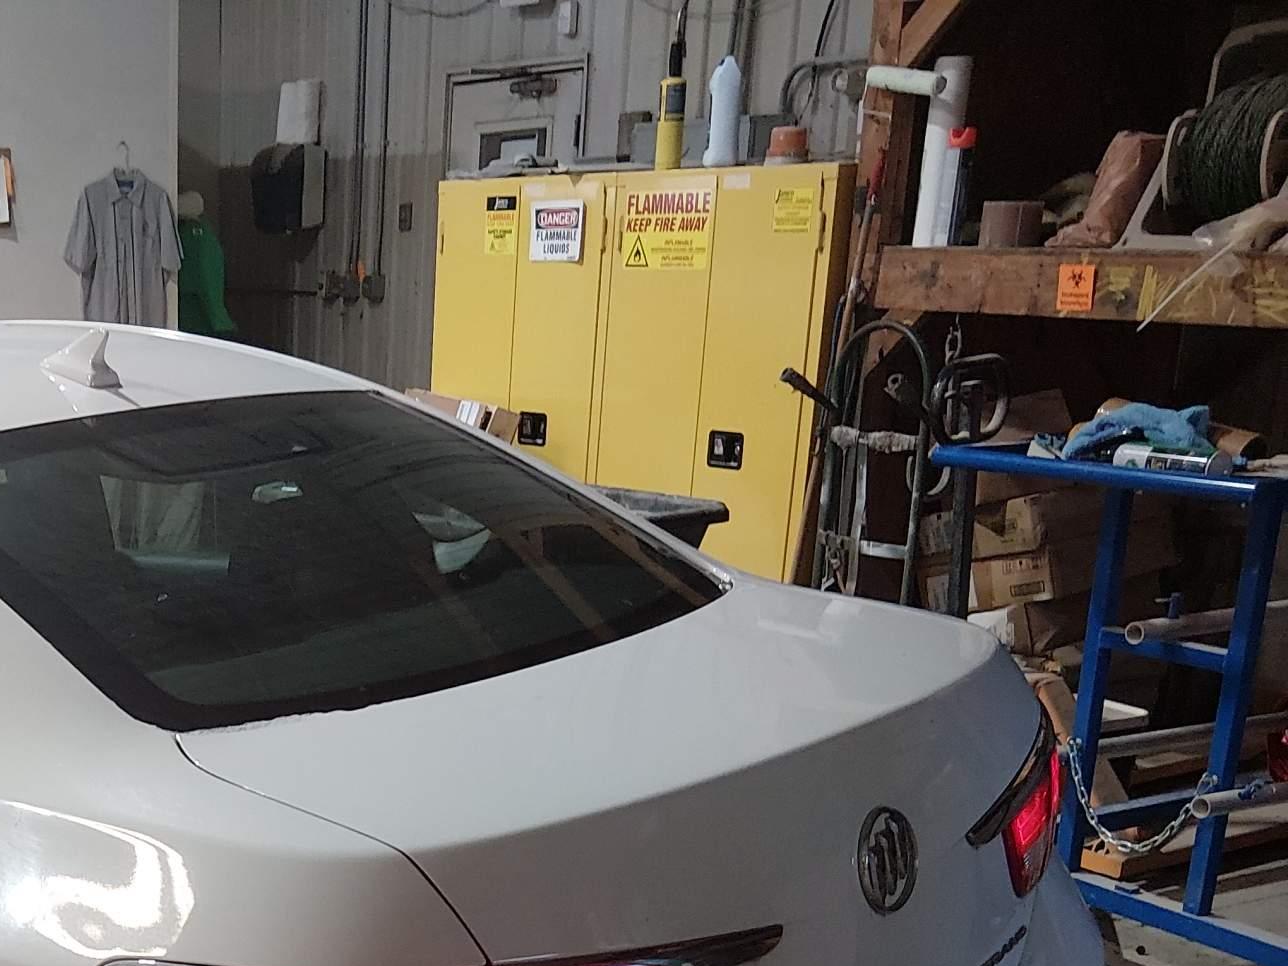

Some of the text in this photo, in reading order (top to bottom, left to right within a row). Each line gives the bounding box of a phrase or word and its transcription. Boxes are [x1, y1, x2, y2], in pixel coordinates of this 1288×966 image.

[627, 192, 711, 215] FLAMMABLE
[539, 211, 578, 225] DANGER
[626, 215, 708, 232] KEEP FIRE AWAY
[536, 230, 577, 241] FLAMMABLE
[543, 243, 570, 255] LIQUIDS
